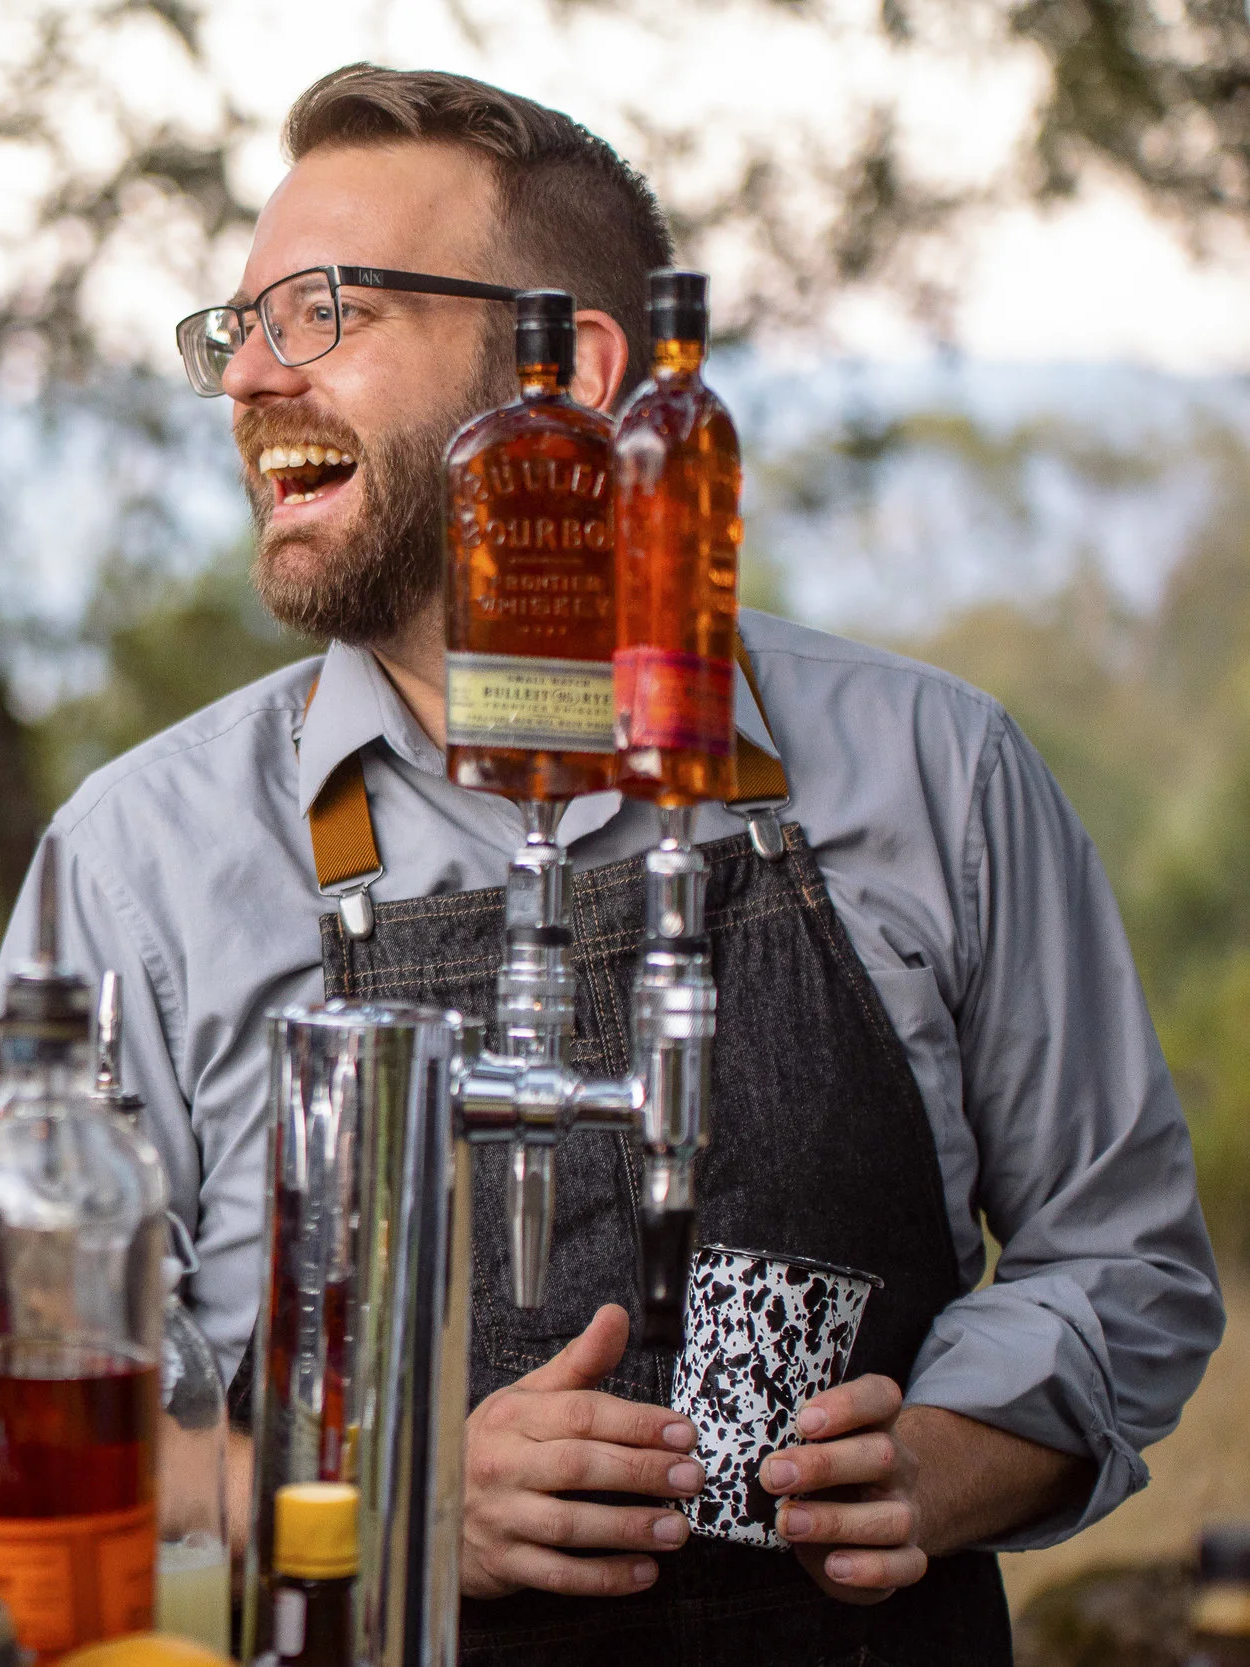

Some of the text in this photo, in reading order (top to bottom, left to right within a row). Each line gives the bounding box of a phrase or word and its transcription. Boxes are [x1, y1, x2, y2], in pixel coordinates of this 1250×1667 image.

[462, 460, 606, 502] BULLEI
[460, 516, 614, 550] BOURBO
[480, 595, 610, 617] WHISKEY
[484, 686, 549, 701] BULLEIT
[582, 691, 612, 704] RYE
